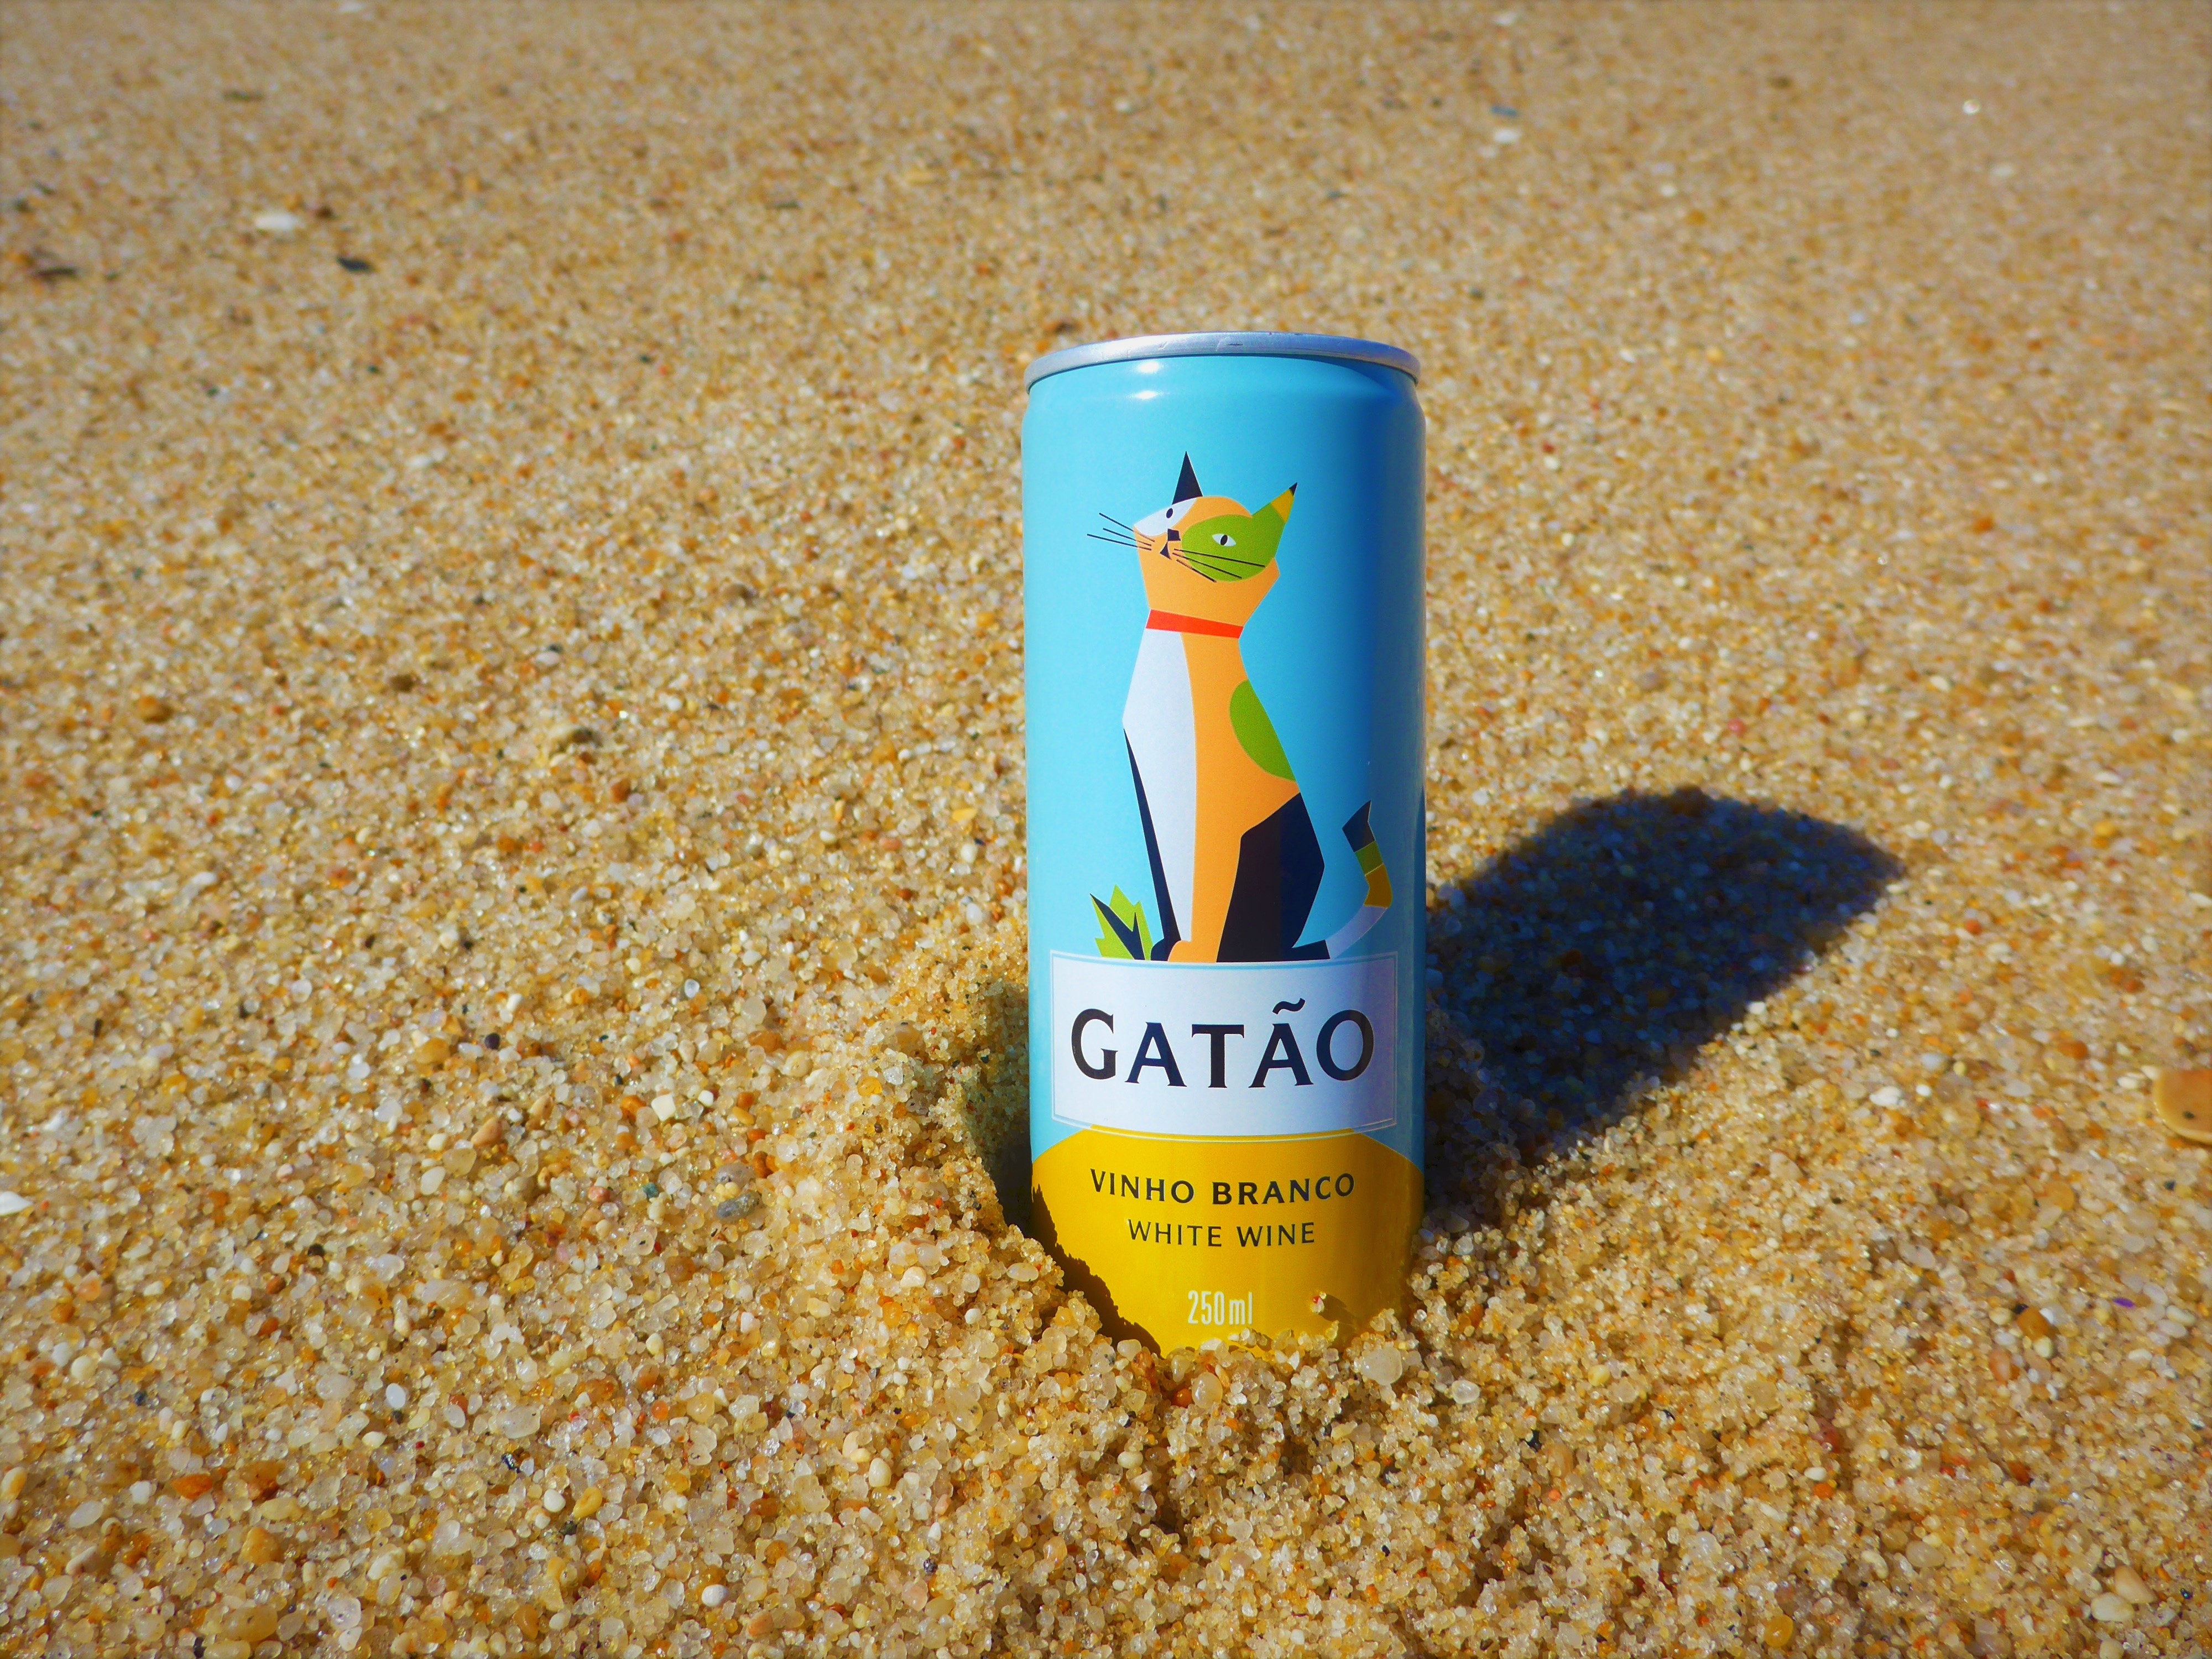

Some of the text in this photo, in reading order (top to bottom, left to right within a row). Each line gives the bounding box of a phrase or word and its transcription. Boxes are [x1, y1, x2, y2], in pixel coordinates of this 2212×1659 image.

[1071, 997, 1375, 1089] GATÃO
[1090, 1168, 1355, 1206] VINHO BRANCO
[1127, 1218, 1315, 1248] WHITE WINE
